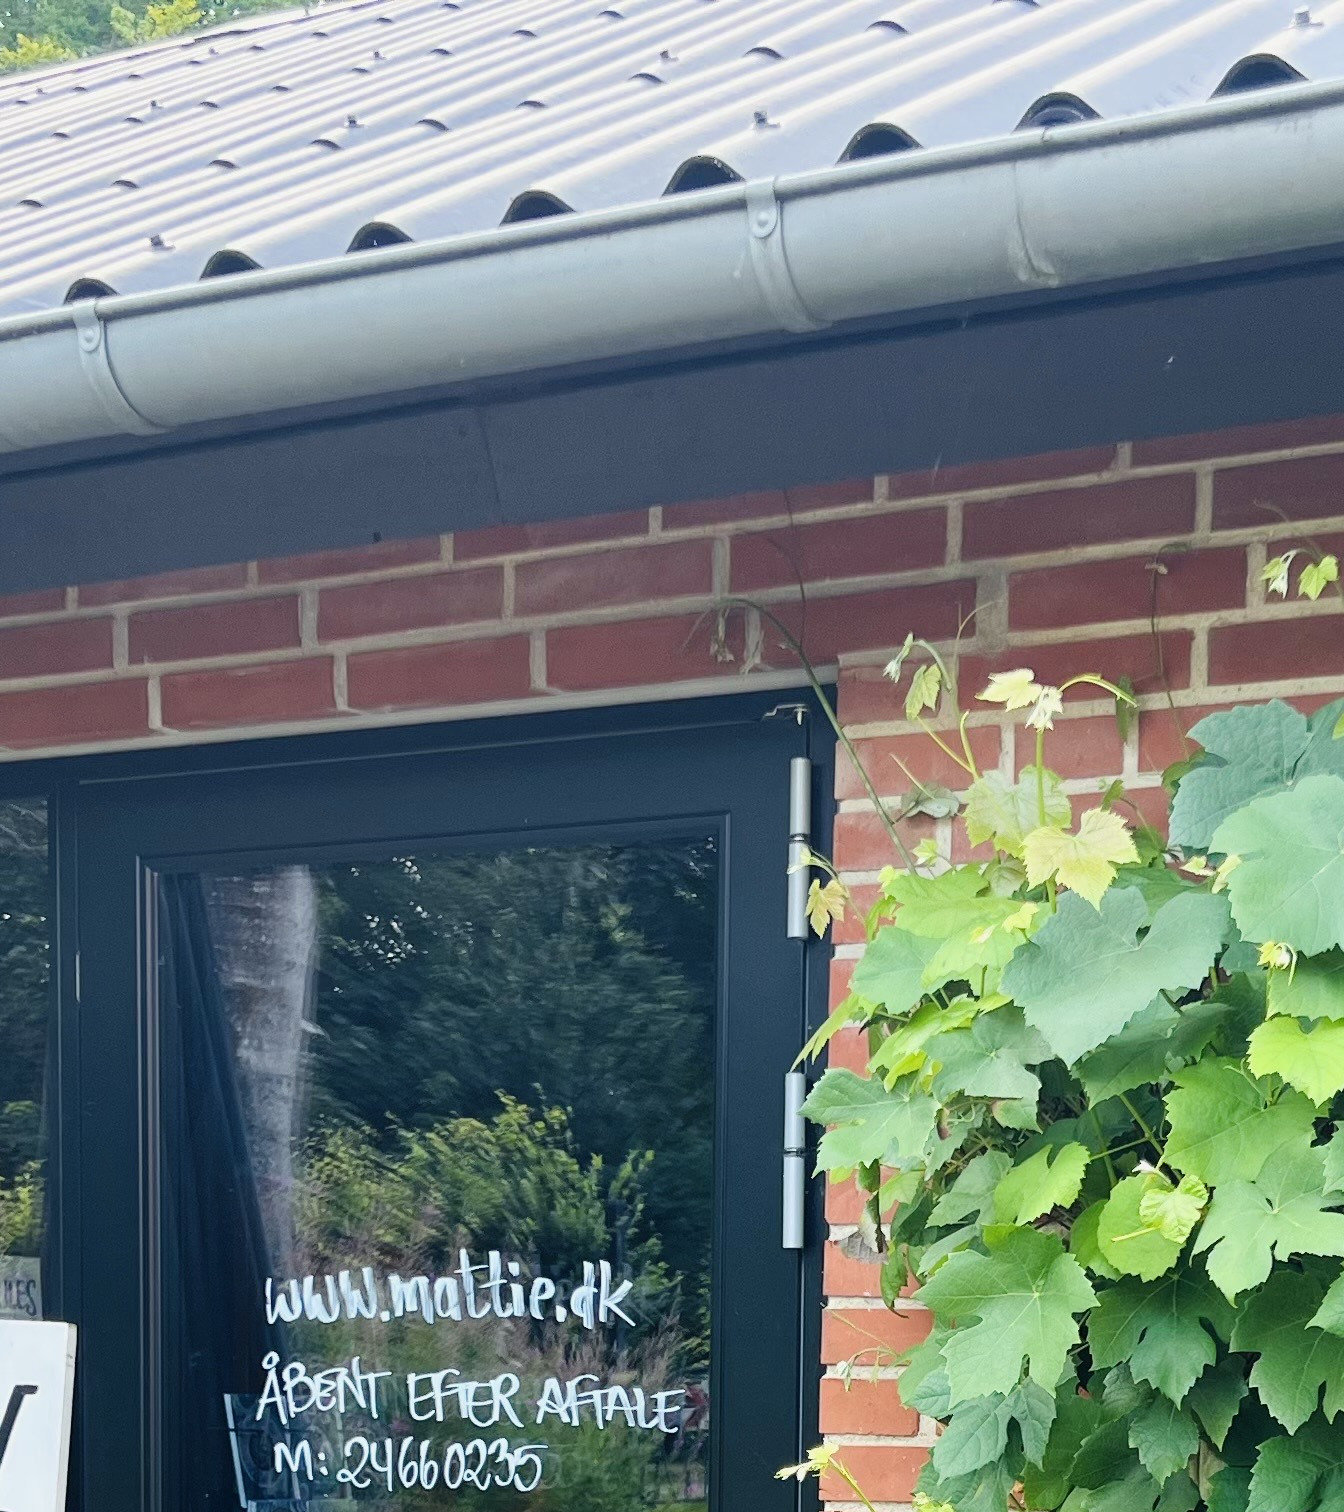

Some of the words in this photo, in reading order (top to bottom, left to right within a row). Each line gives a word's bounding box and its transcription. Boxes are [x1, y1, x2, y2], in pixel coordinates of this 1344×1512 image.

[265, 1248, 636, 1330] www.mattie.dk
[255, 1350, 393, 1426] ÅBENT
[406, 1369, 524, 1430] EFTER
[537, 1374, 686, 1434] AFTALE
